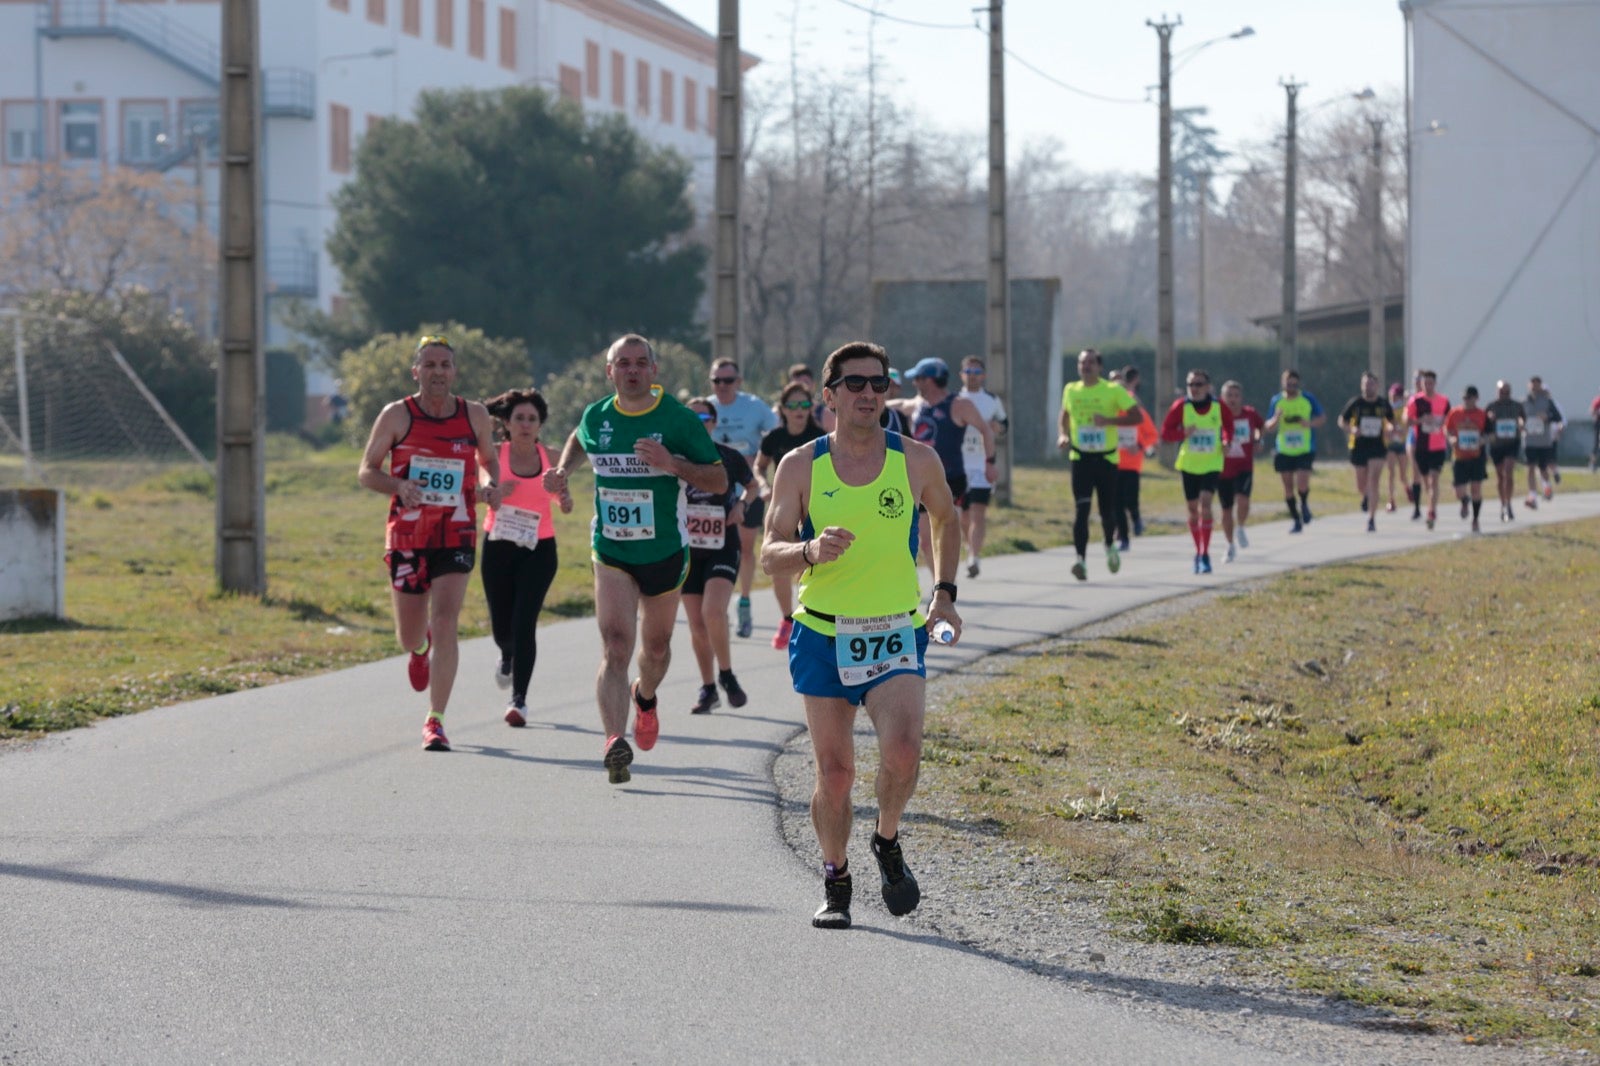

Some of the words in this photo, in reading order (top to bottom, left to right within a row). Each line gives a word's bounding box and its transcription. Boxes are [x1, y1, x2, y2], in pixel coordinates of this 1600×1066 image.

[596, 457, 621, 467] CAJA
[419, 471, 454, 490] 569
[608, 505, 641, 524] 691
[687, 518, 722, 535] 208
[850, 633, 903, 662] 976
